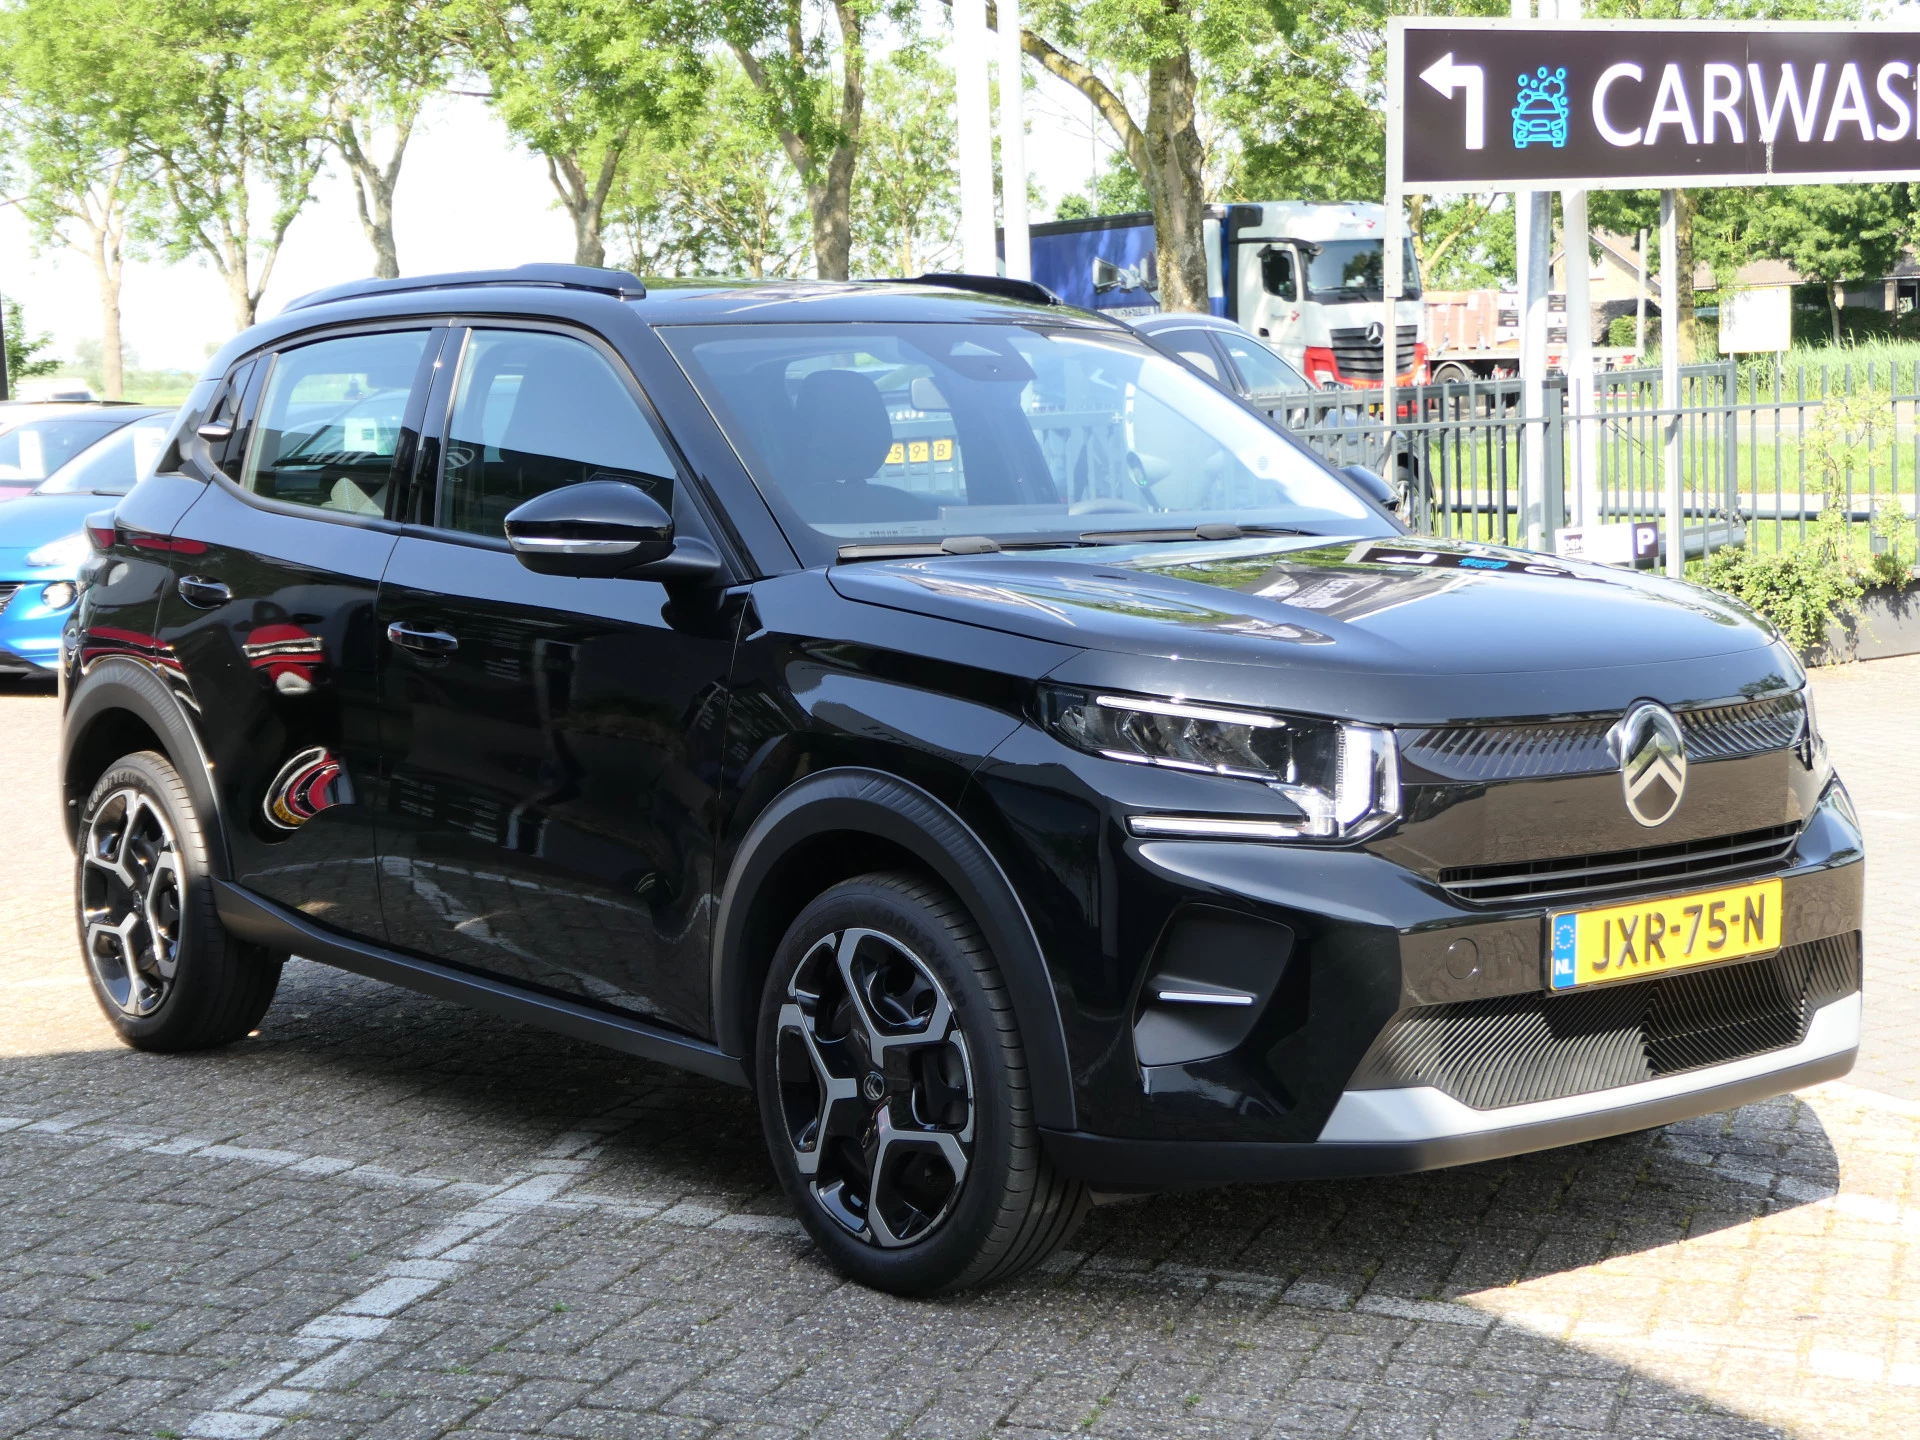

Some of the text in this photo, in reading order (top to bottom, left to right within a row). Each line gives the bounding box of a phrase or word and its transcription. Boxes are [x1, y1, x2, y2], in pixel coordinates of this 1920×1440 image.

[1592, 62, 1920, 147] CARWAS
[1636, 527, 1655, 555] P
[1592, 893, 1765, 972] JXR-75-N
[1555, 958, 1573, 976] NL
